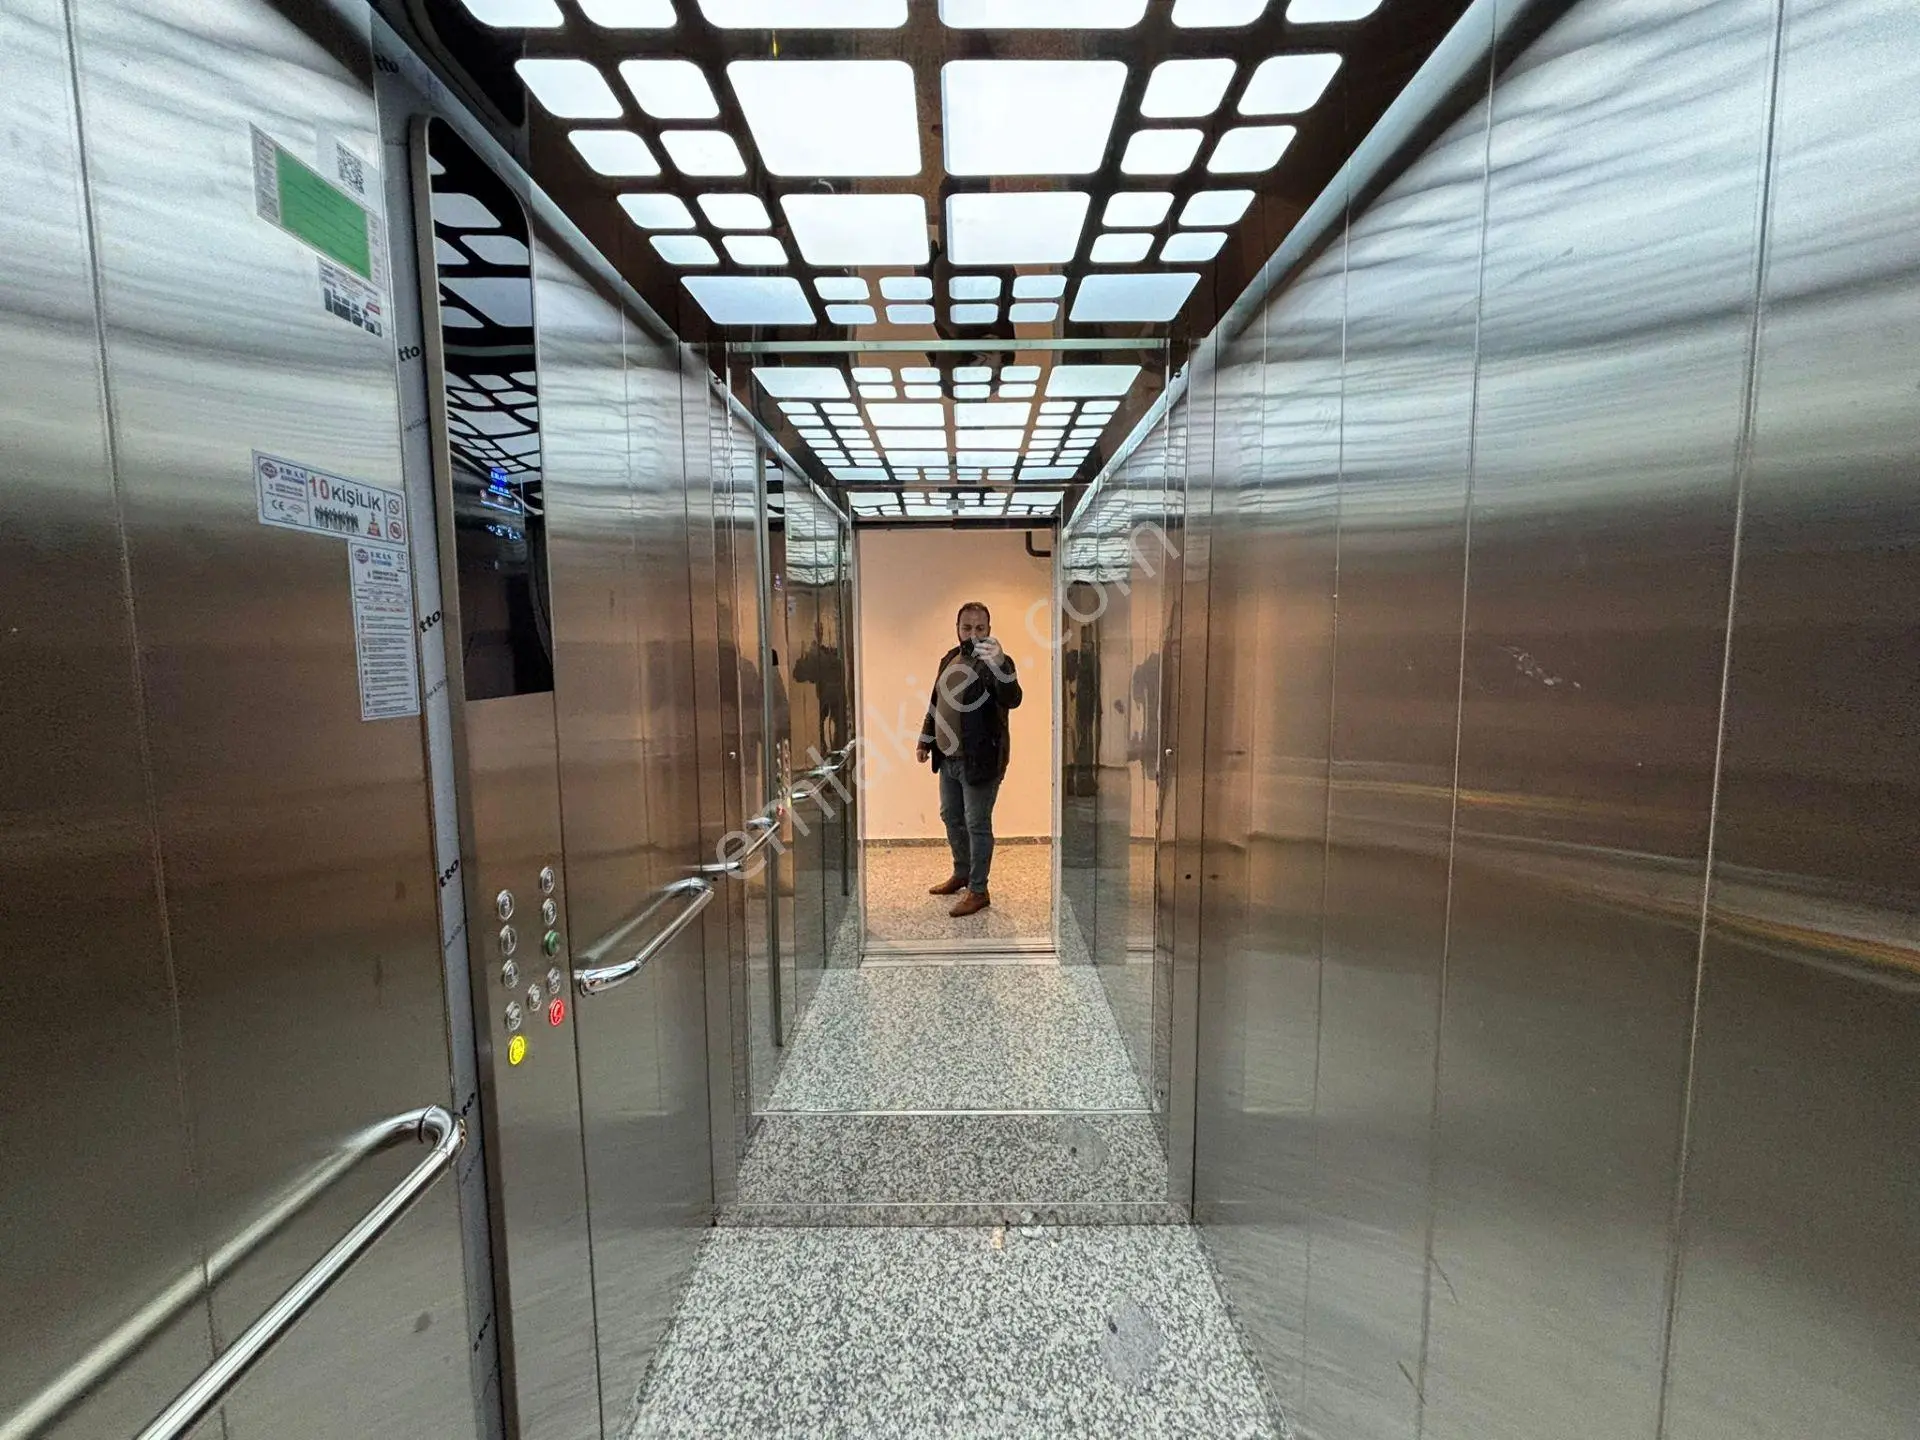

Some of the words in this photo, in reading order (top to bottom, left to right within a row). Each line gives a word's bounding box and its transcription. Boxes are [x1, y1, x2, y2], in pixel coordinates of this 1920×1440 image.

[398, 346, 421, 362] tto
[309, 475, 330, 501] 10
[331, 485, 382, 512] KİŞİLİK
[419, 610, 442, 633] tto
